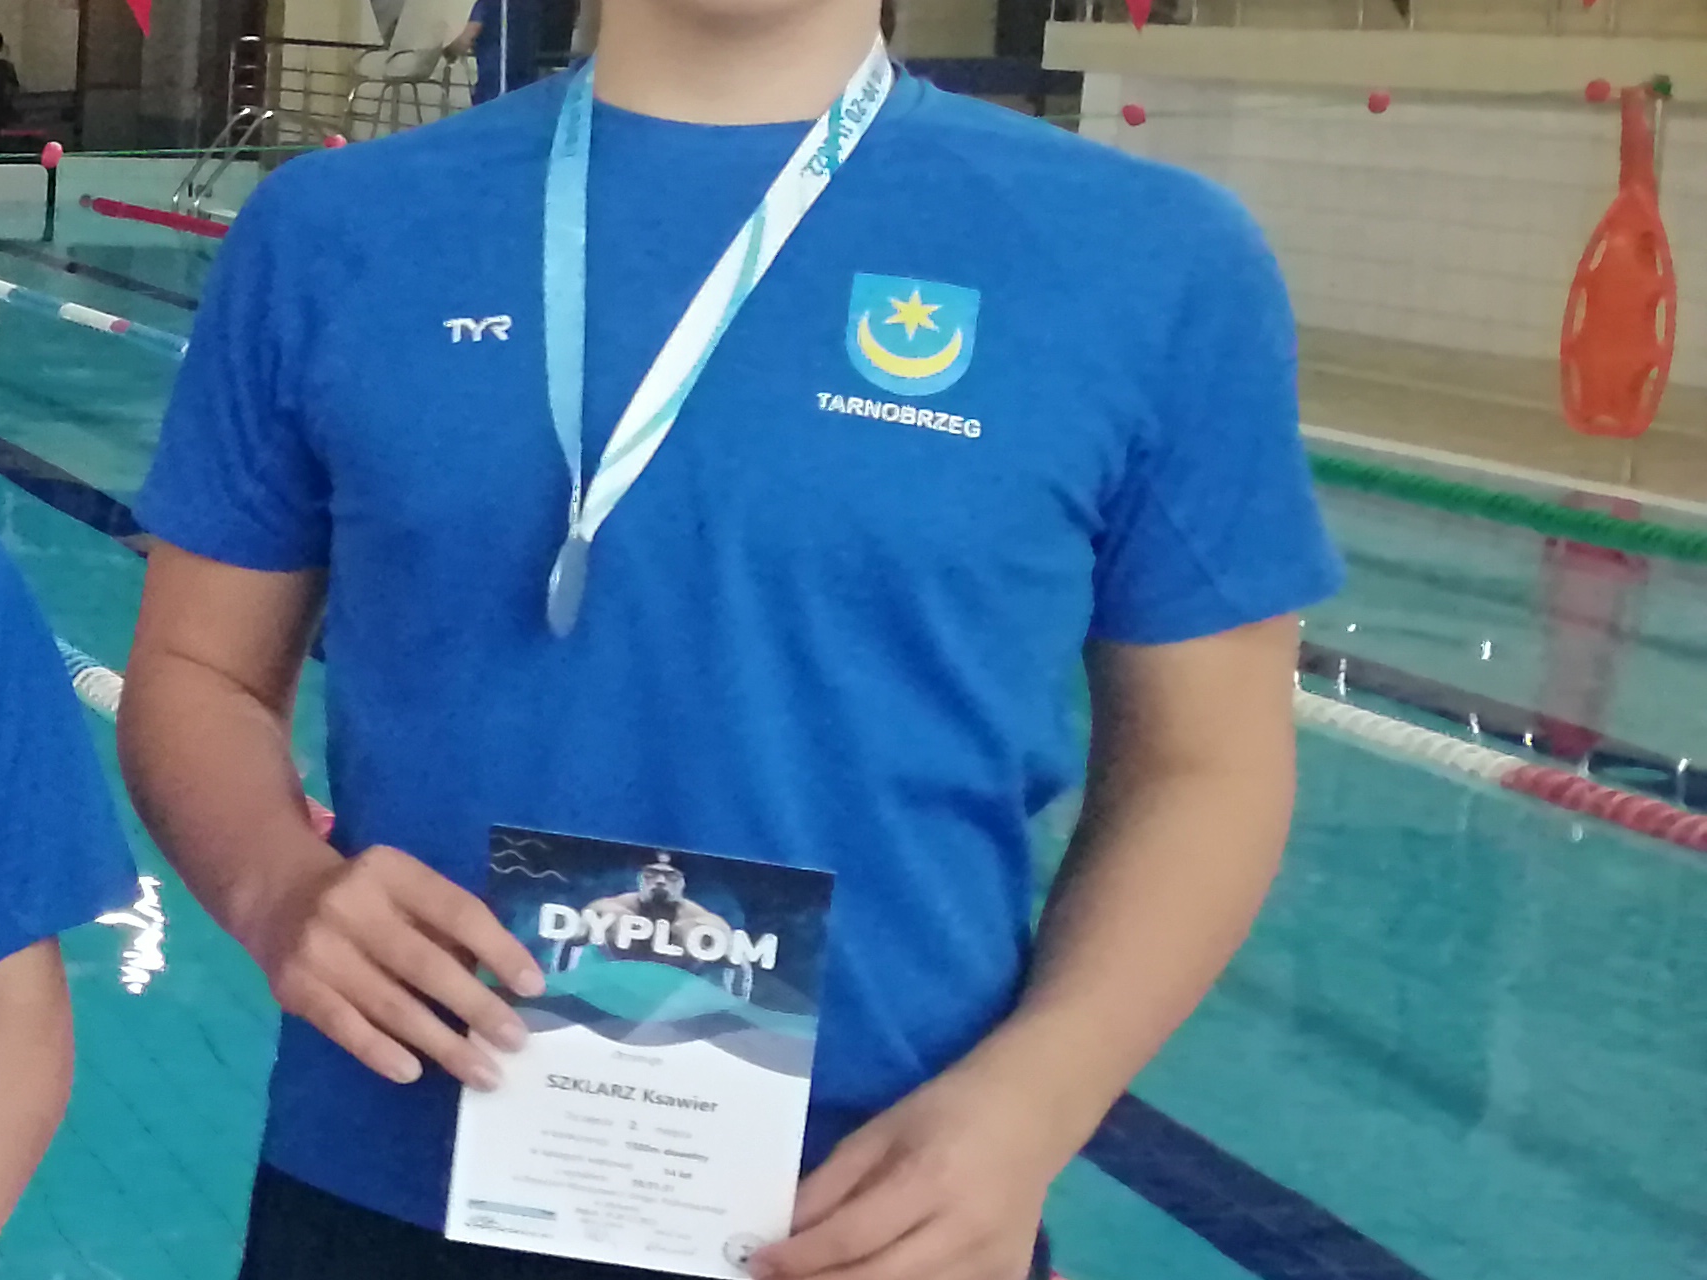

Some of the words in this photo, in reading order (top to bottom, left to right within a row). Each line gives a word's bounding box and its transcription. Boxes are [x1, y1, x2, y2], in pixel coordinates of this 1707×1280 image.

[443, 314, 512, 343] TYR
[816, 392, 982, 439] TARNOBRZEG
[538, 902, 779, 971] DYPLOM
[545, 1073, 637, 1101] SZKLARZ
[643, 1088, 719, 1112] Ksawier
